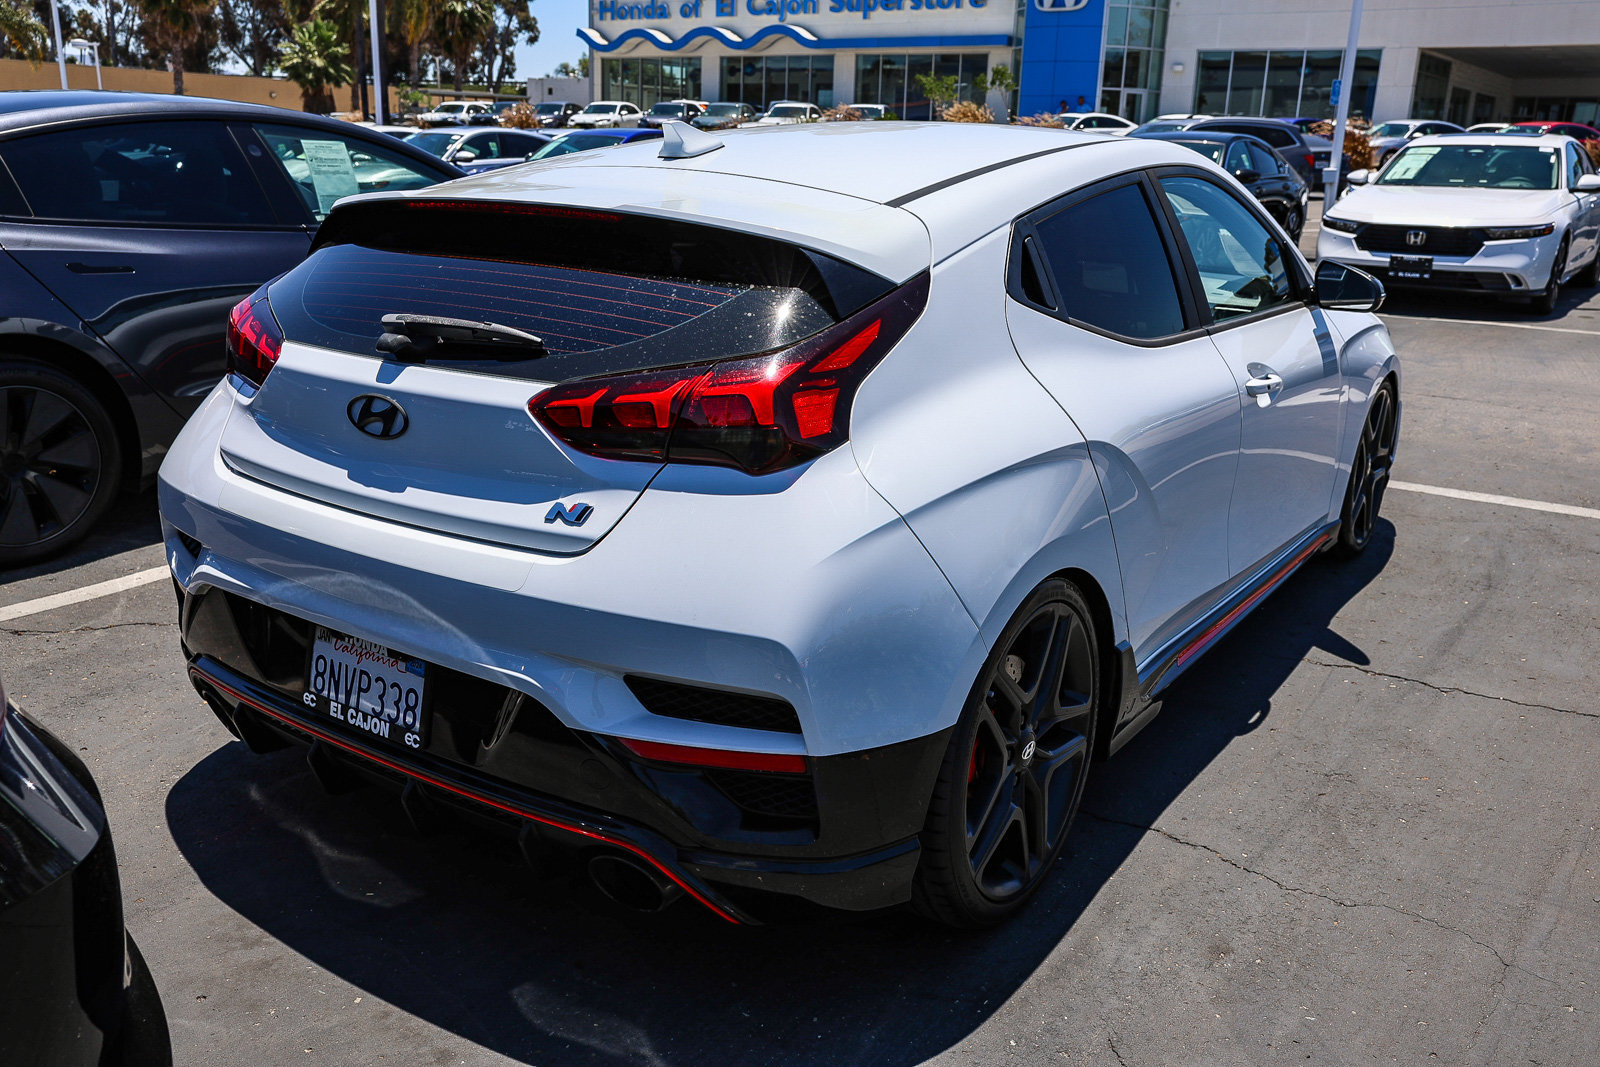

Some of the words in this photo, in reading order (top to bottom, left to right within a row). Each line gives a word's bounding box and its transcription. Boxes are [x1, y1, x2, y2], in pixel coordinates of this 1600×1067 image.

[600, 0, 670, 20] Honda
[680, 0, 703, 18] of
[715, 0, 736, 17] El
[747, 0, 819, 22] Cajon
[334, 638, 407, 673] California
[313, 655, 419, 729] 8NVP338
[329, 700, 345, 720] EL
[347, 708, 390, 738] CAJON
